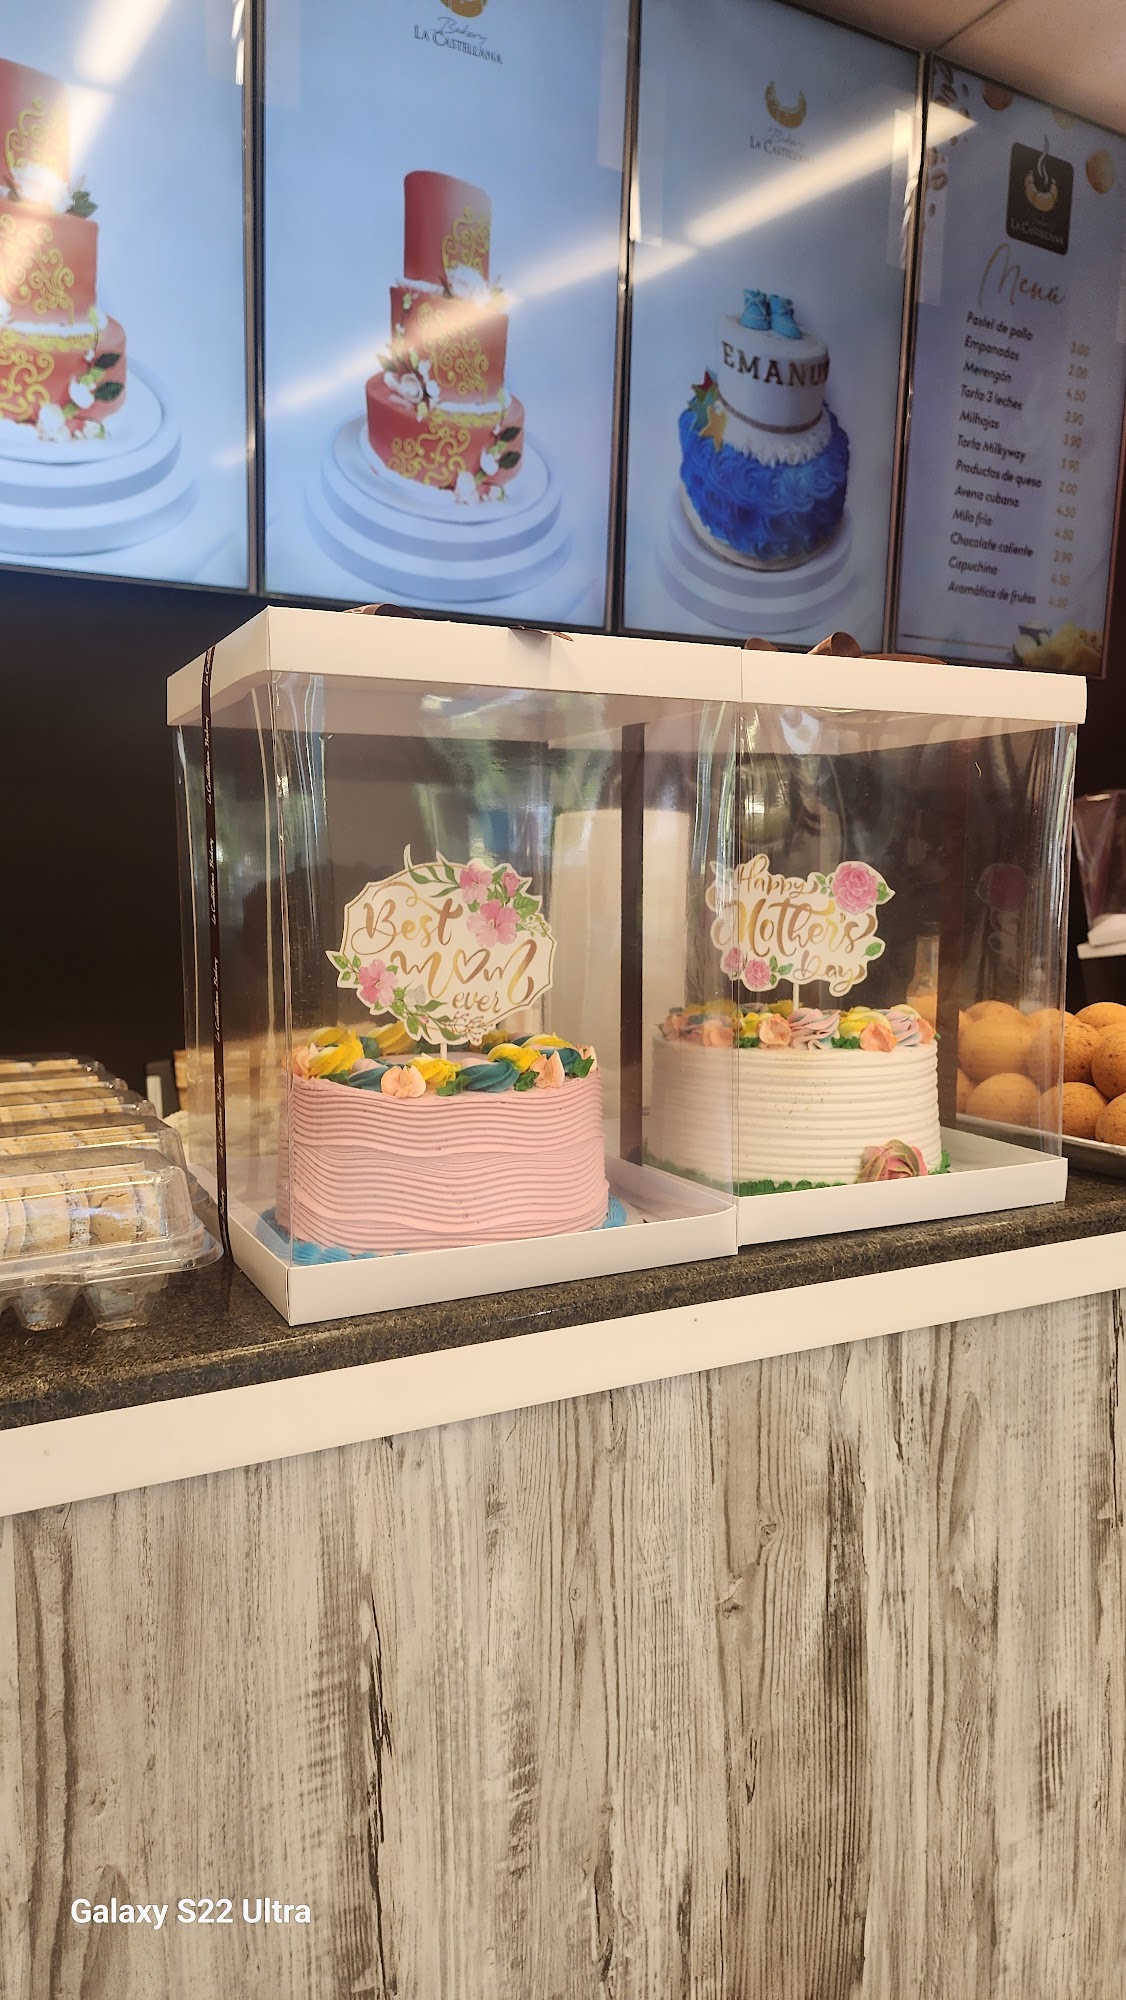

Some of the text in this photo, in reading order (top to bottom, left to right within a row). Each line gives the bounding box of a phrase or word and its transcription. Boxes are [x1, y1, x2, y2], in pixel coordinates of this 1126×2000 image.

[722, 340, 830, 386] EMANU
[735, 853, 820, 898] Happy
[351, 881, 464, 955] Best
[452, 990, 502, 1014] ever
